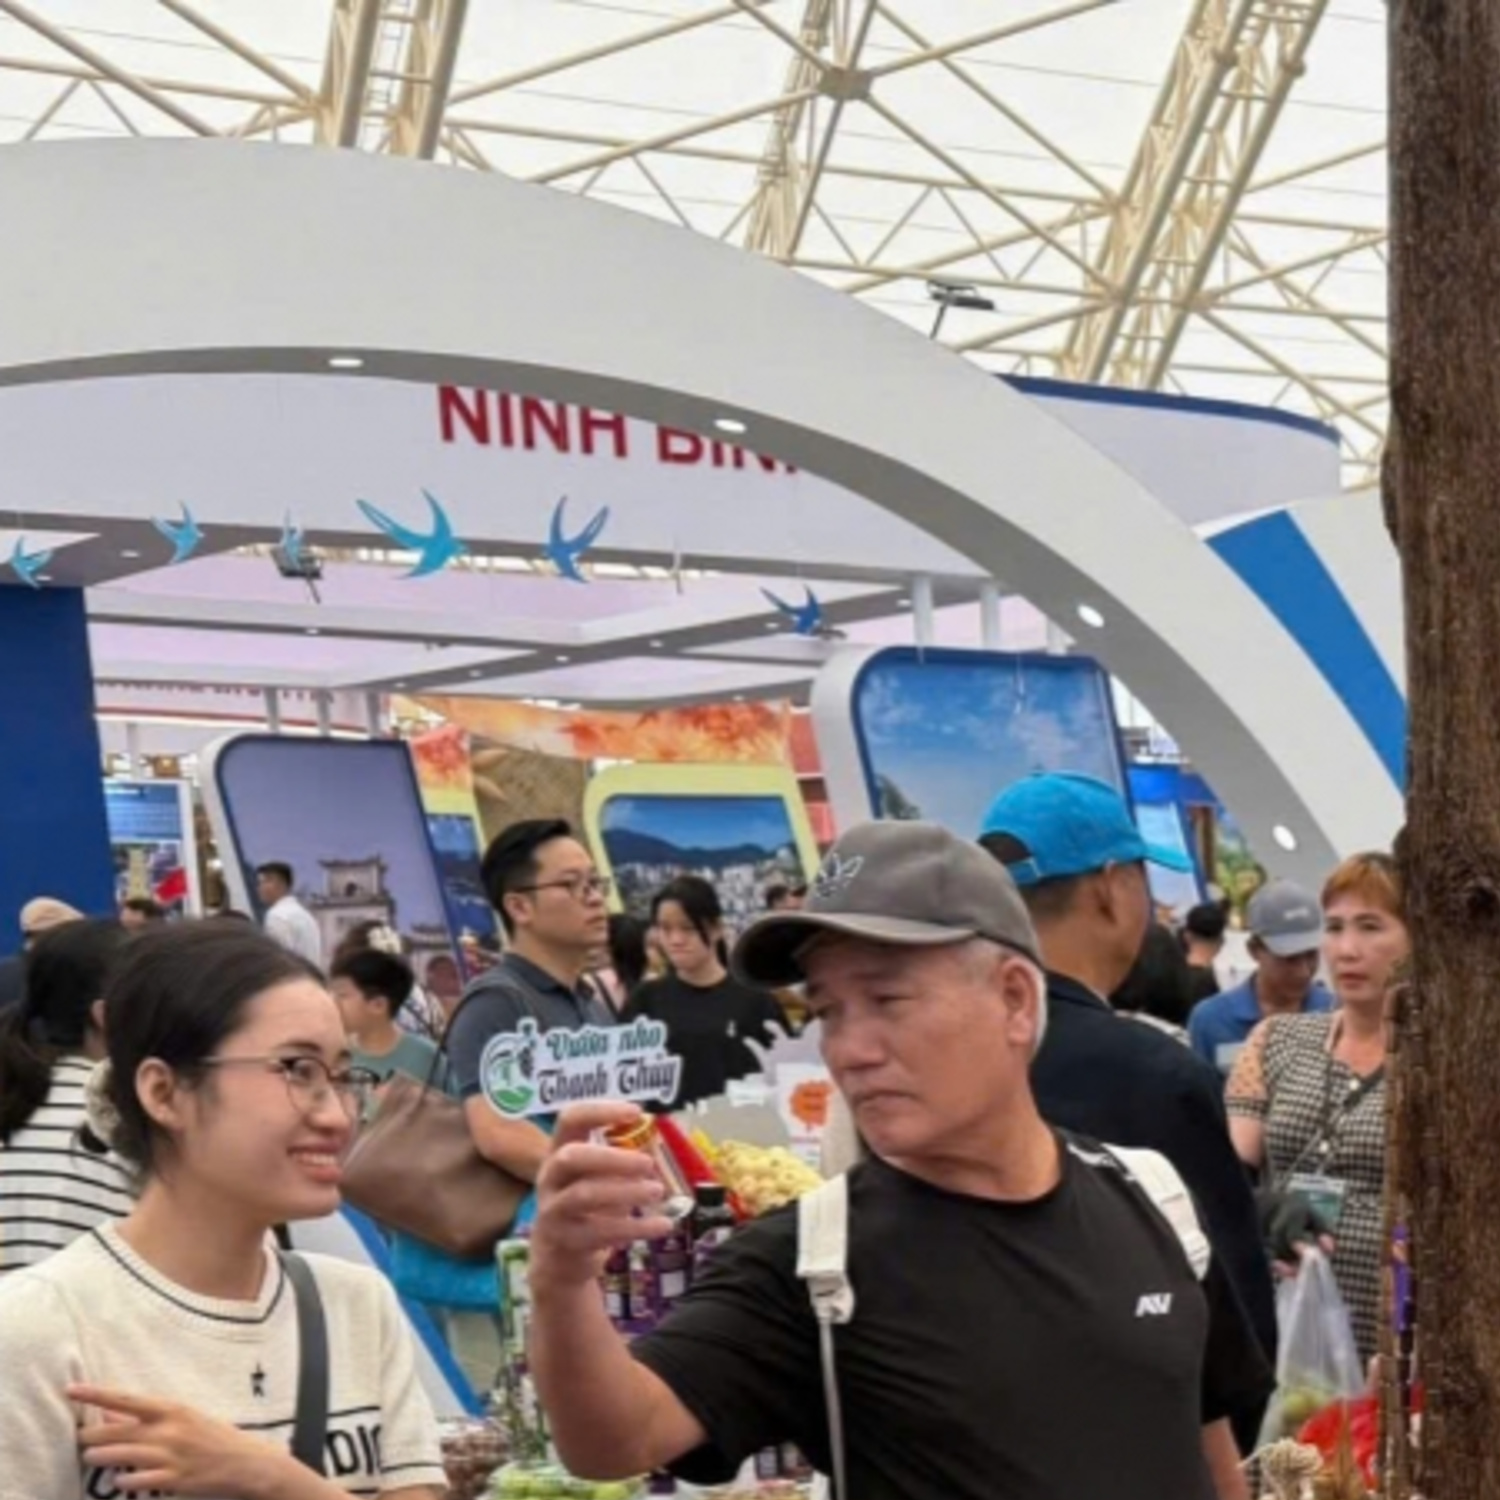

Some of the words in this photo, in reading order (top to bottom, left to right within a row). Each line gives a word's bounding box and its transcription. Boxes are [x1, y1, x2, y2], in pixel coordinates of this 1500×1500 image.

[438, 384, 628, 458] NINH
[619, 1022, 661, 1052] nho
[537, 1063, 608, 1104] Thanh
